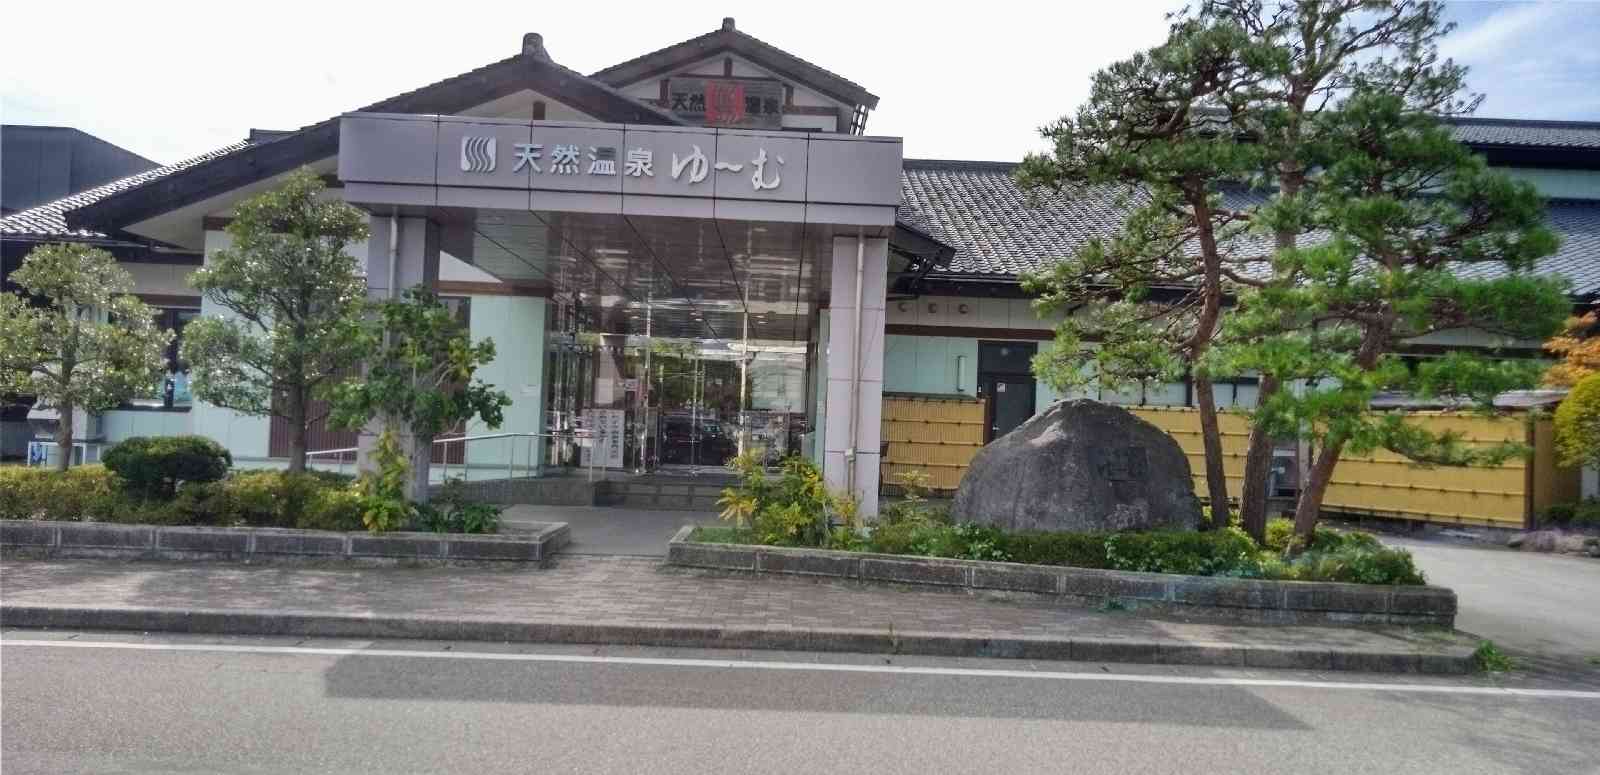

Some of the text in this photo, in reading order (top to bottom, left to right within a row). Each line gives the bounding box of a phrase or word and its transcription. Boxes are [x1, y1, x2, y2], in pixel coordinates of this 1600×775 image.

[671, 92, 705, 112] 天然
[513, 143, 654, 177] 天然温泉
